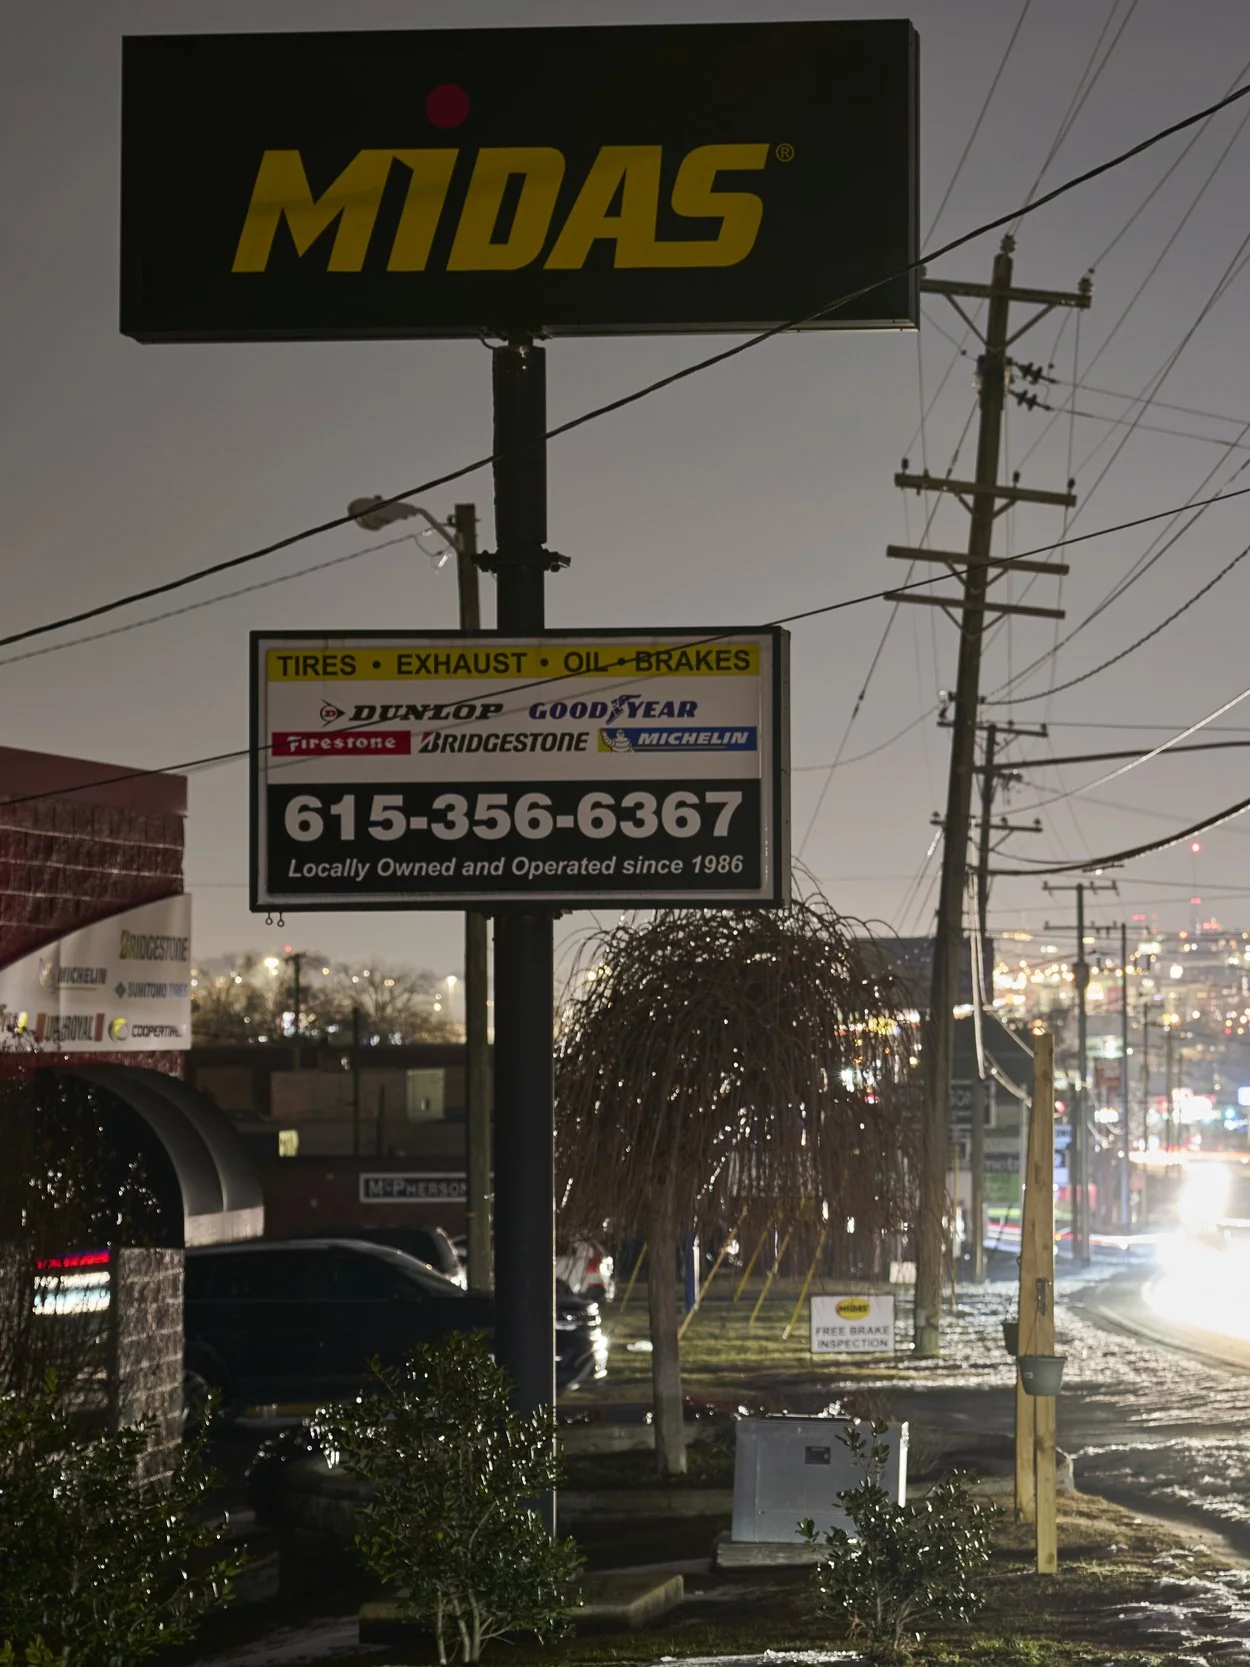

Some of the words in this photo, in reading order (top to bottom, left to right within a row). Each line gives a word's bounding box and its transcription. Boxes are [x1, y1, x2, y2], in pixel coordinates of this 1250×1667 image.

[232, 143, 770, 274] MIDAS
[277, 655, 357, 676] TIRES
[397, 652, 527, 675] EXHAUST
[564, 651, 609, 673] OIL
[635, 649, 751, 672] BRAKES
[348, 703, 504, 722] DUNLOP
[528, 697, 699, 722] GOODYEAR
[286, 735, 397, 753] Firestone
[418, 731, 590, 754] BRIDGESTONE
[637, 731, 750, 746] MICHELIN
[284, 791, 744, 842] 615-356-6367
[288, 857, 369, 882] Locally
[375, 857, 457, 878] Owned
[461, 856, 508, 877] and
[510, 856, 616, 879] Operated
[621, 855, 684, 875] since
[692, 855, 744, 875] 1986
[119, 930, 189, 962] BRIDGESTONE
[56, 966, 107, 985] MICHELIN
[131, 1024, 187, 1038] COOPERTIR
[816, 1327, 845, 1336] FREE
[850, 1326, 889, 1335] BRAKE
[818, 1340, 888, 1349] INSPECTION
